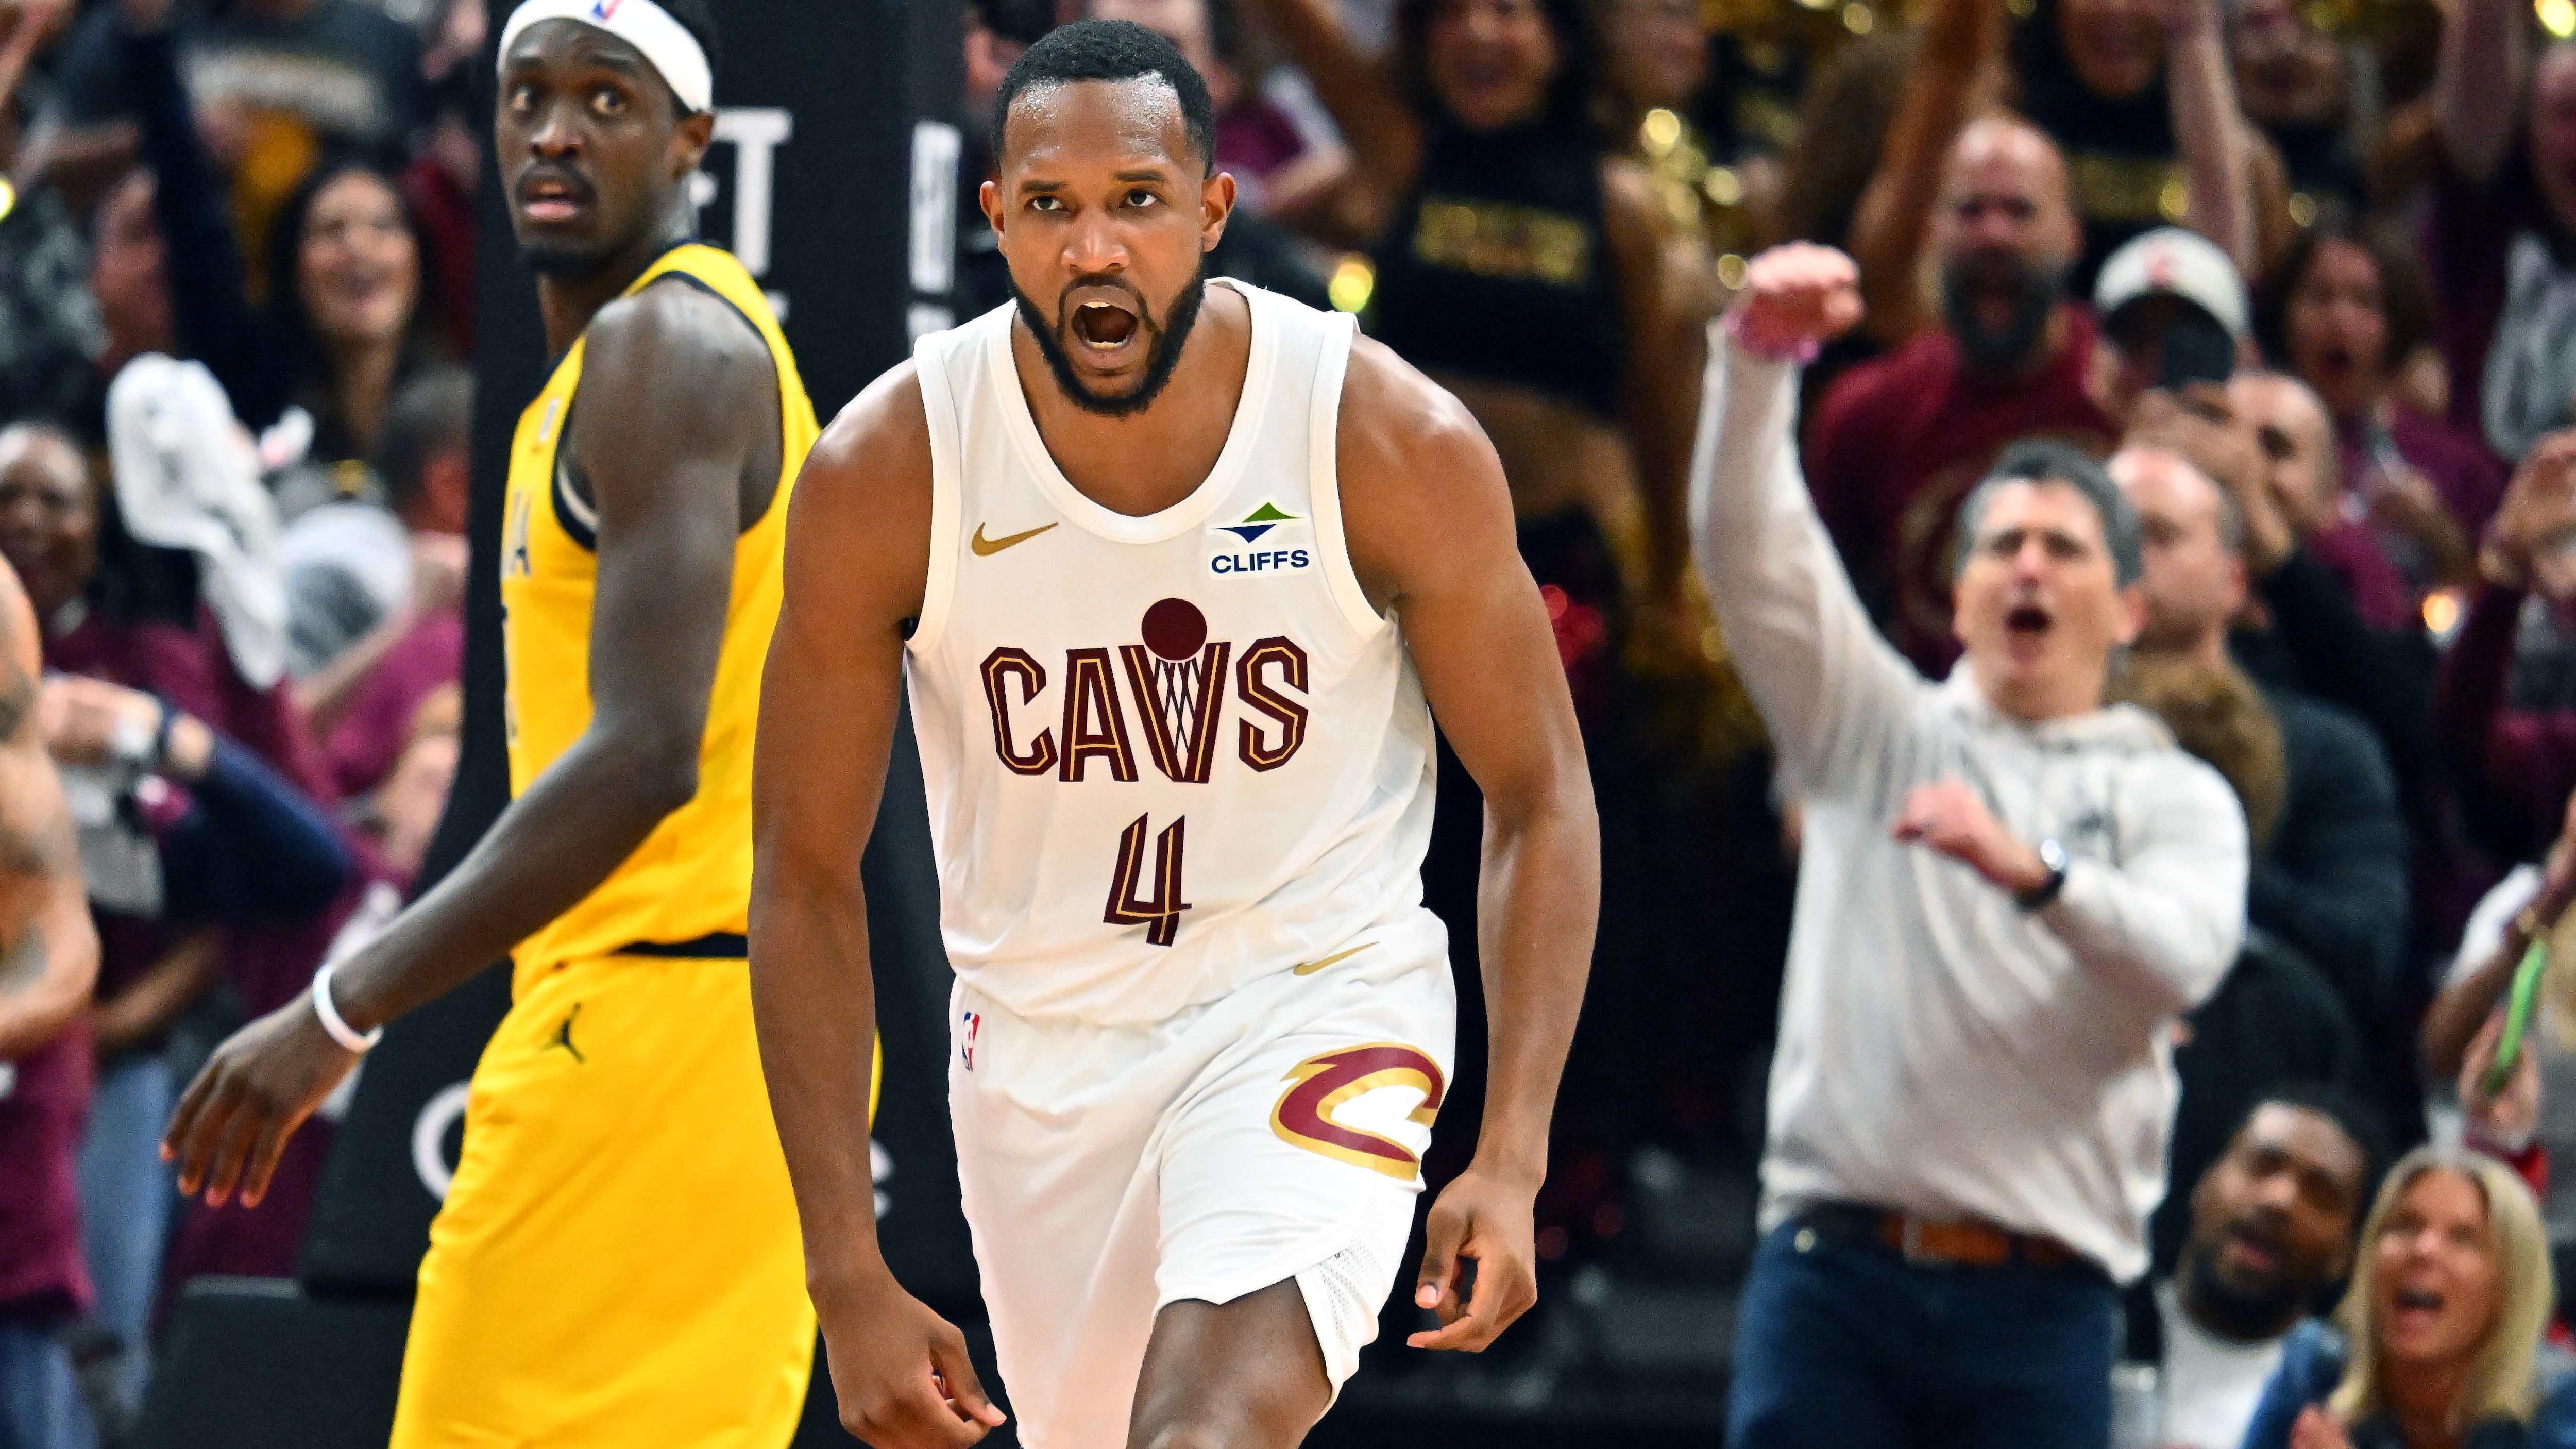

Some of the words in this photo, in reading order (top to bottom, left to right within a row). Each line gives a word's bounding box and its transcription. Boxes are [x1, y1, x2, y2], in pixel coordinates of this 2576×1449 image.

[1211, 549, 1309, 574] CLIFFS
[980, 636, 1309, 784] CAVS
[1103, 812, 1192, 947] 4
